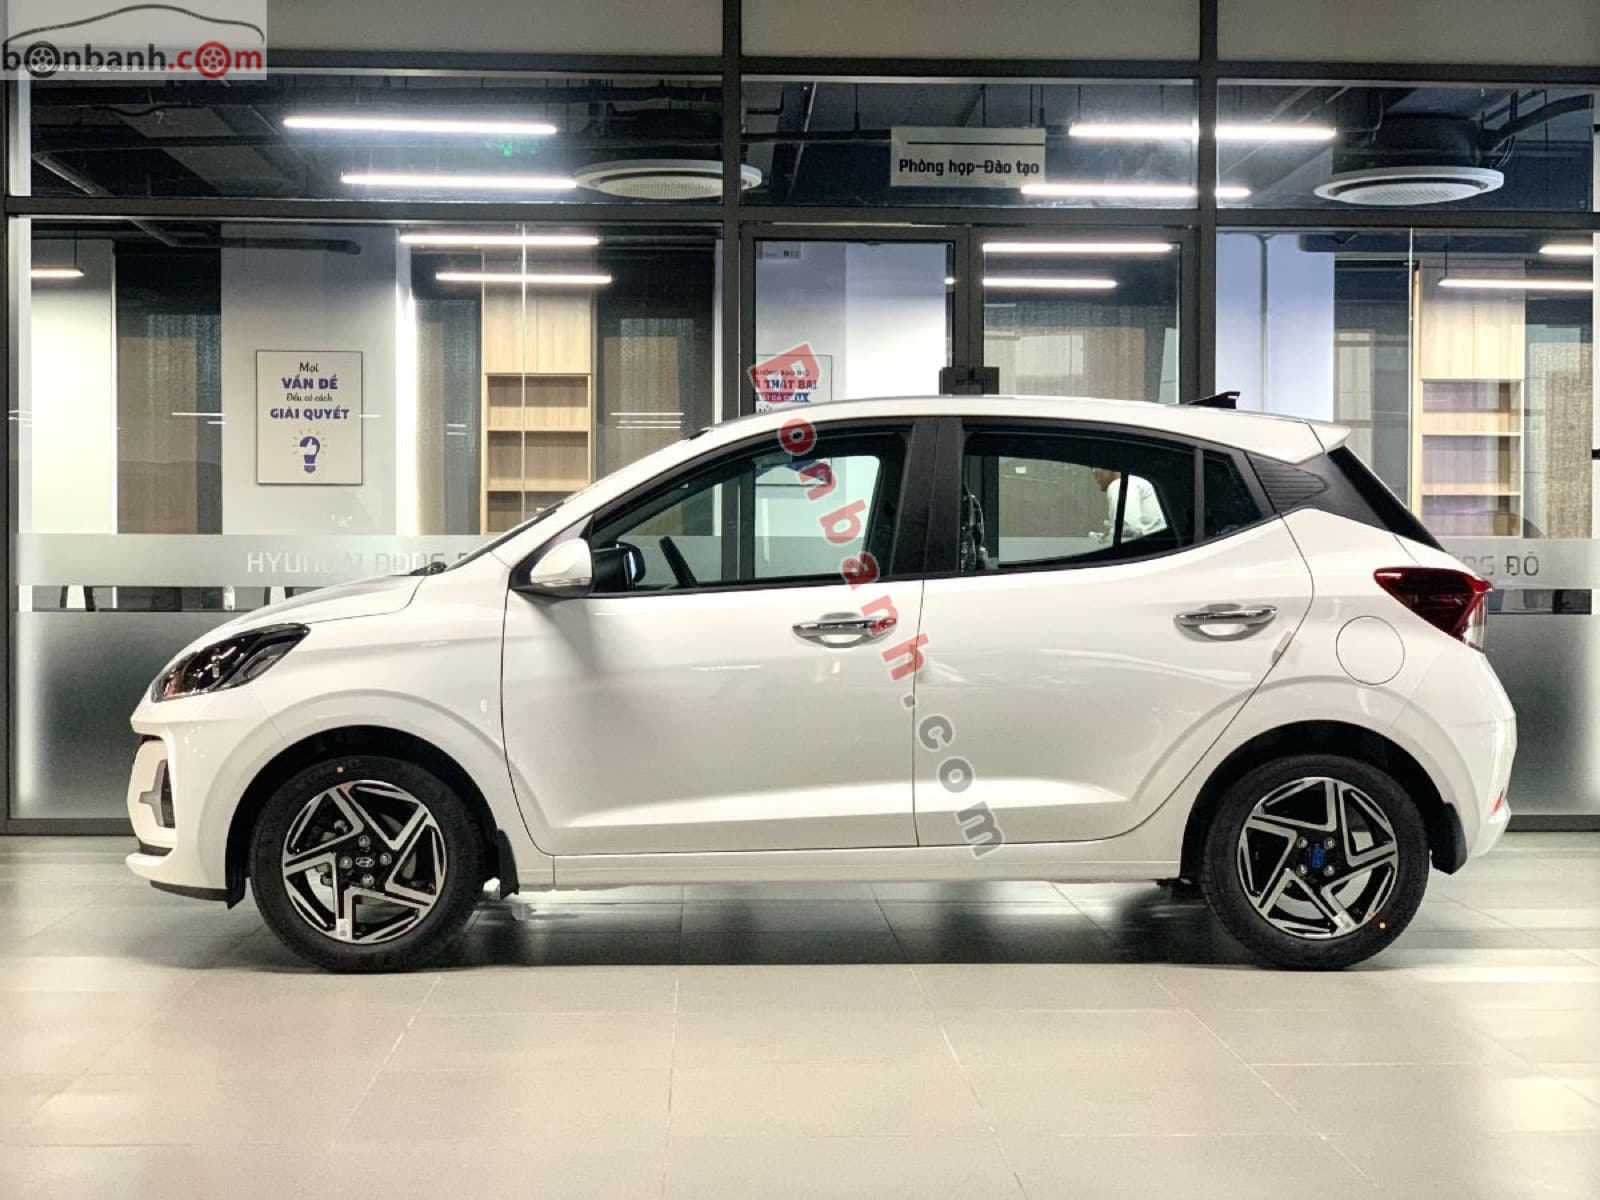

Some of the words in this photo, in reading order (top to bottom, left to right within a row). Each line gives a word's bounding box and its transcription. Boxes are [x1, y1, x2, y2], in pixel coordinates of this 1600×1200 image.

[899, 159, 944, 176] Phòng
[1016, 160, 1040, 177] tạo
[281, 373, 313, 390] VẤN
[303, 404, 350, 421] QUYẾT
[1504, 551, 1540, 576] ĐÔ
